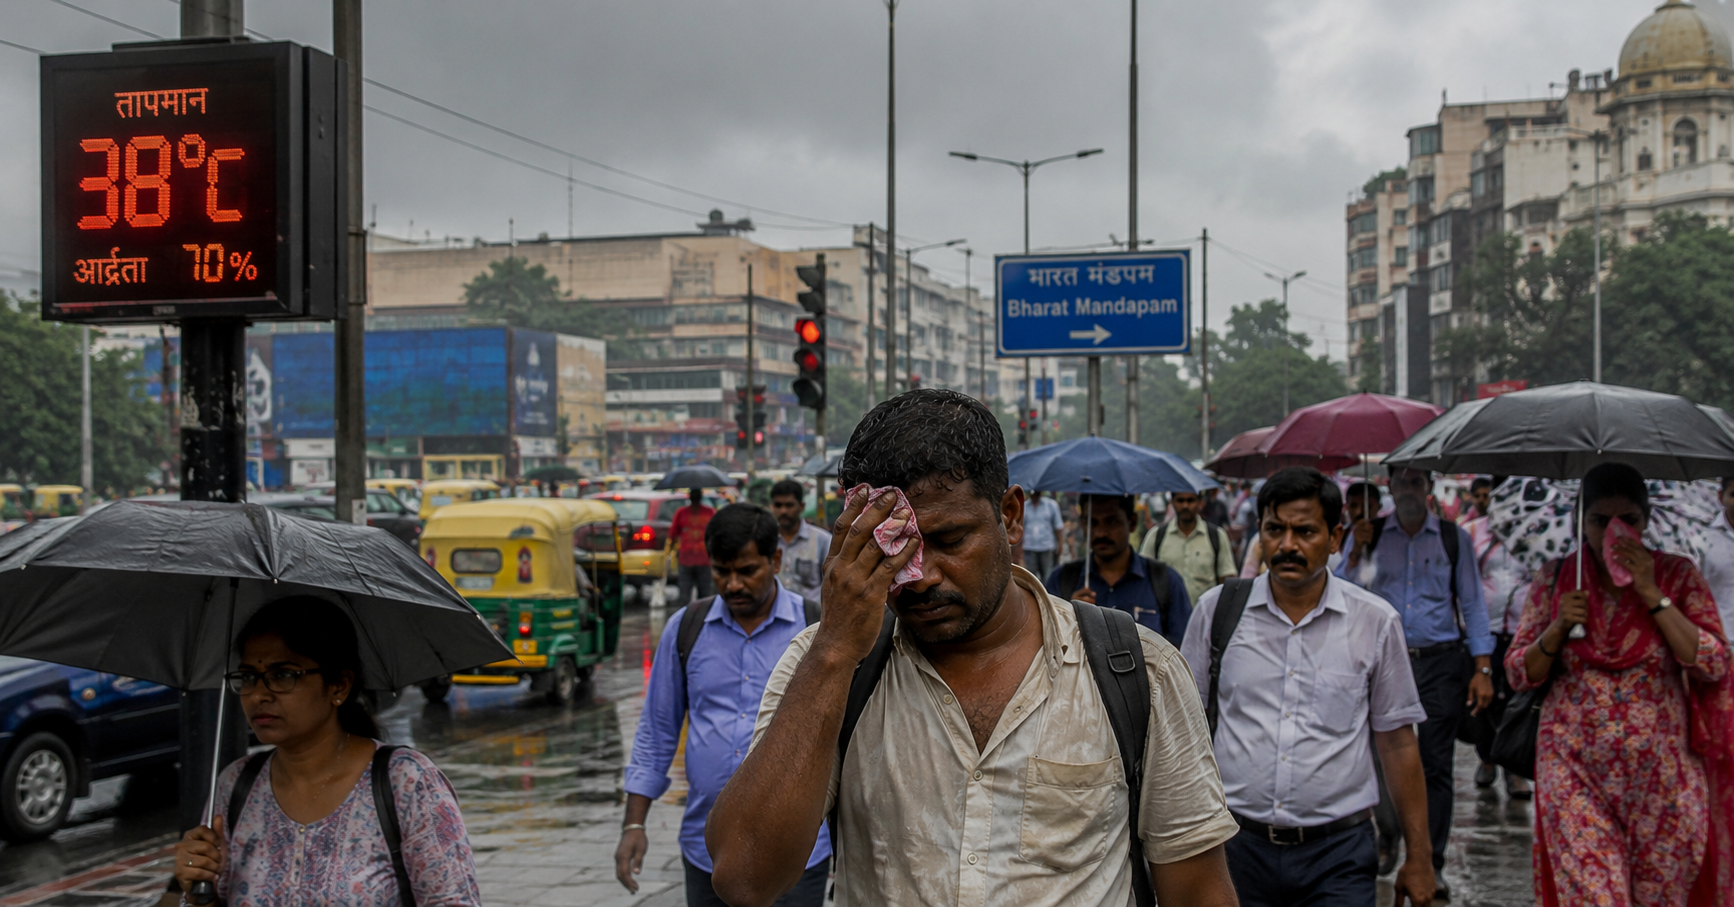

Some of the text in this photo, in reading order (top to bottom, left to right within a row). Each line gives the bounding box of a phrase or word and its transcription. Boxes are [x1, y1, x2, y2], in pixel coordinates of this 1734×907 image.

[114, 87, 208, 119] तापमान
[77, 133, 245, 230] 38°C
[73, 247, 149, 286] आर्द्रता
[1028, 263, 1155, 287] भारत मंडपम
[1008, 296, 1178, 319] Bharat Mandapam
